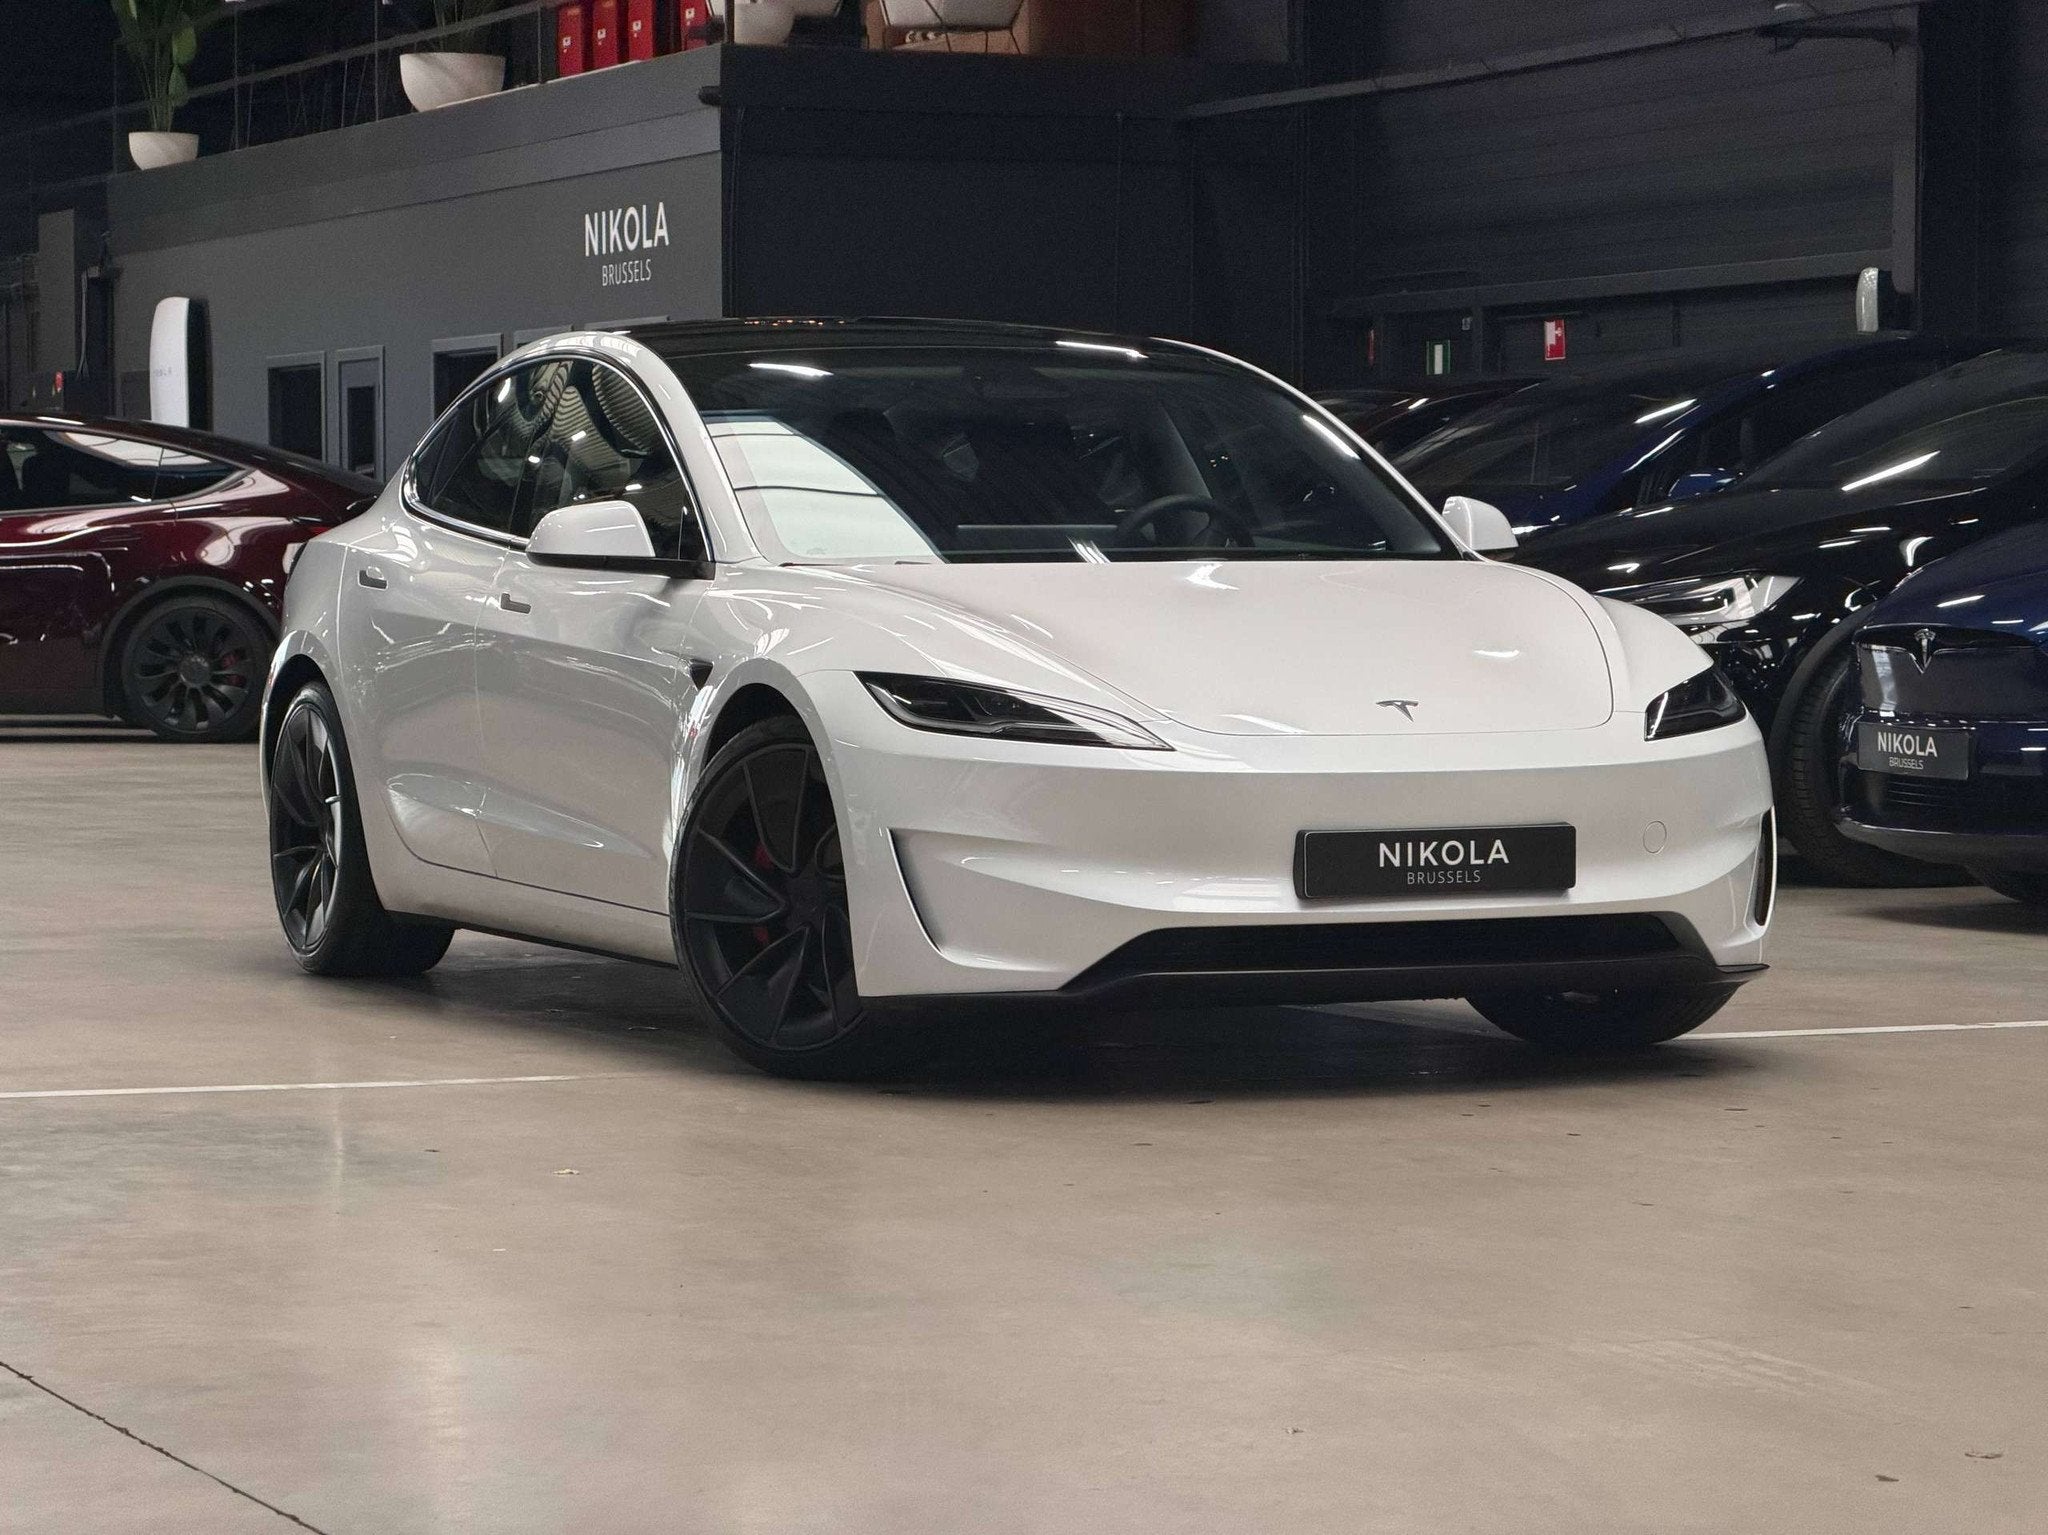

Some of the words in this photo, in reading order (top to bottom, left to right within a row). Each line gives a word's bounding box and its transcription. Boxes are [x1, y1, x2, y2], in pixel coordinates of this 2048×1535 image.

[585, 202, 669, 256] NIKOLA
[602, 259, 651, 286] BRUSSELS
[1878, 732, 1938, 757] NIKOLA
[1889, 757, 1924, 769] BRUSSELS
[1379, 839, 1509, 867] NIKOLA
[1407, 870, 1481, 885] BRUSSELS
